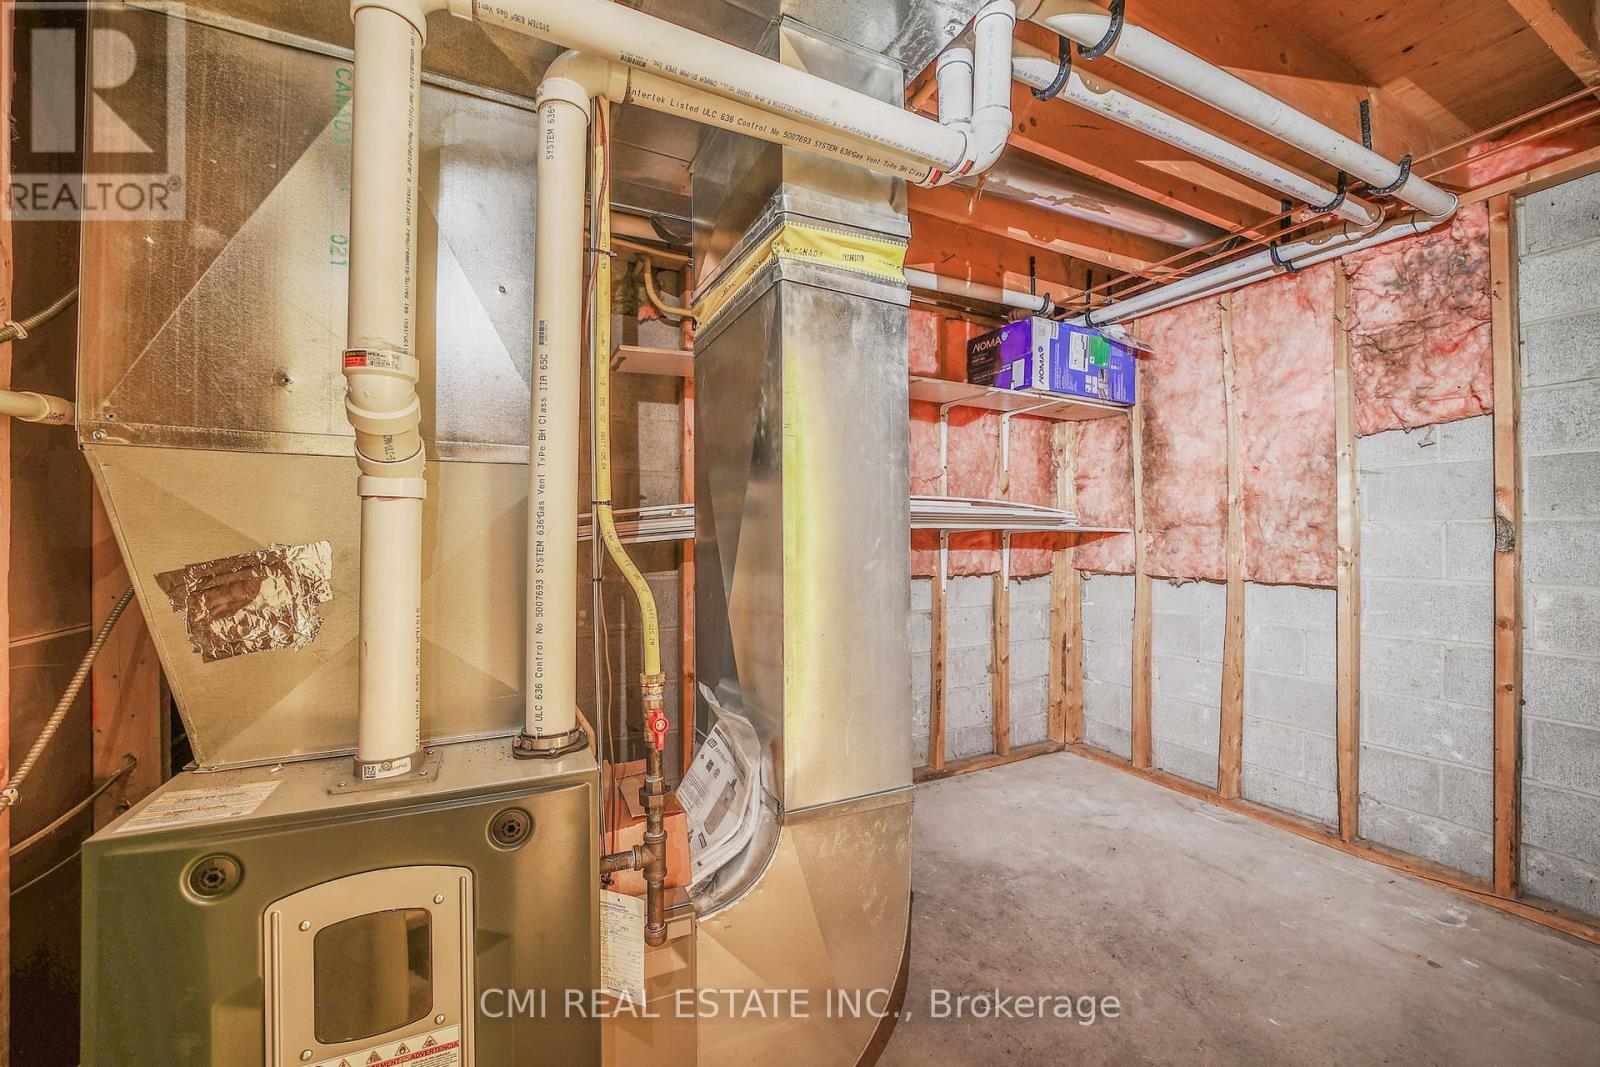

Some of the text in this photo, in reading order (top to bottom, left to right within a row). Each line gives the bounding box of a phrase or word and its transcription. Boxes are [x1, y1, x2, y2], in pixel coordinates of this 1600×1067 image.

[546, 128, 555, 160] SYSTEM
[669, 98, 699, 113] Listed
[702, 108, 718, 118] ULC
[720, 113, 735, 123] 636
[737, 118, 767, 133] Control
[770, 127, 780, 136] No
[783, 131, 812, 145] 5007693
[814, 140, 838, 153] SYSTEM
[866, 155, 881, 165] Vent
[898, 165, 908, 173] BH
[908, 168, 926, 179] Class
[972, 337, 1002, 354] NOMA
[540, 354, 548, 370] 65C
[1037, 353, 1046, 385] NOMA
[538, 429, 546, 440] BH
[537, 473, 545, 495] Vent
[536, 540, 544, 574] SYSTEM
[535, 579, 544, 617] 5007693
[535, 623, 543, 634] No
[535, 641, 543, 678] Control
[535, 683, 543, 699] 636
[535, 705, 543, 721] ULC
